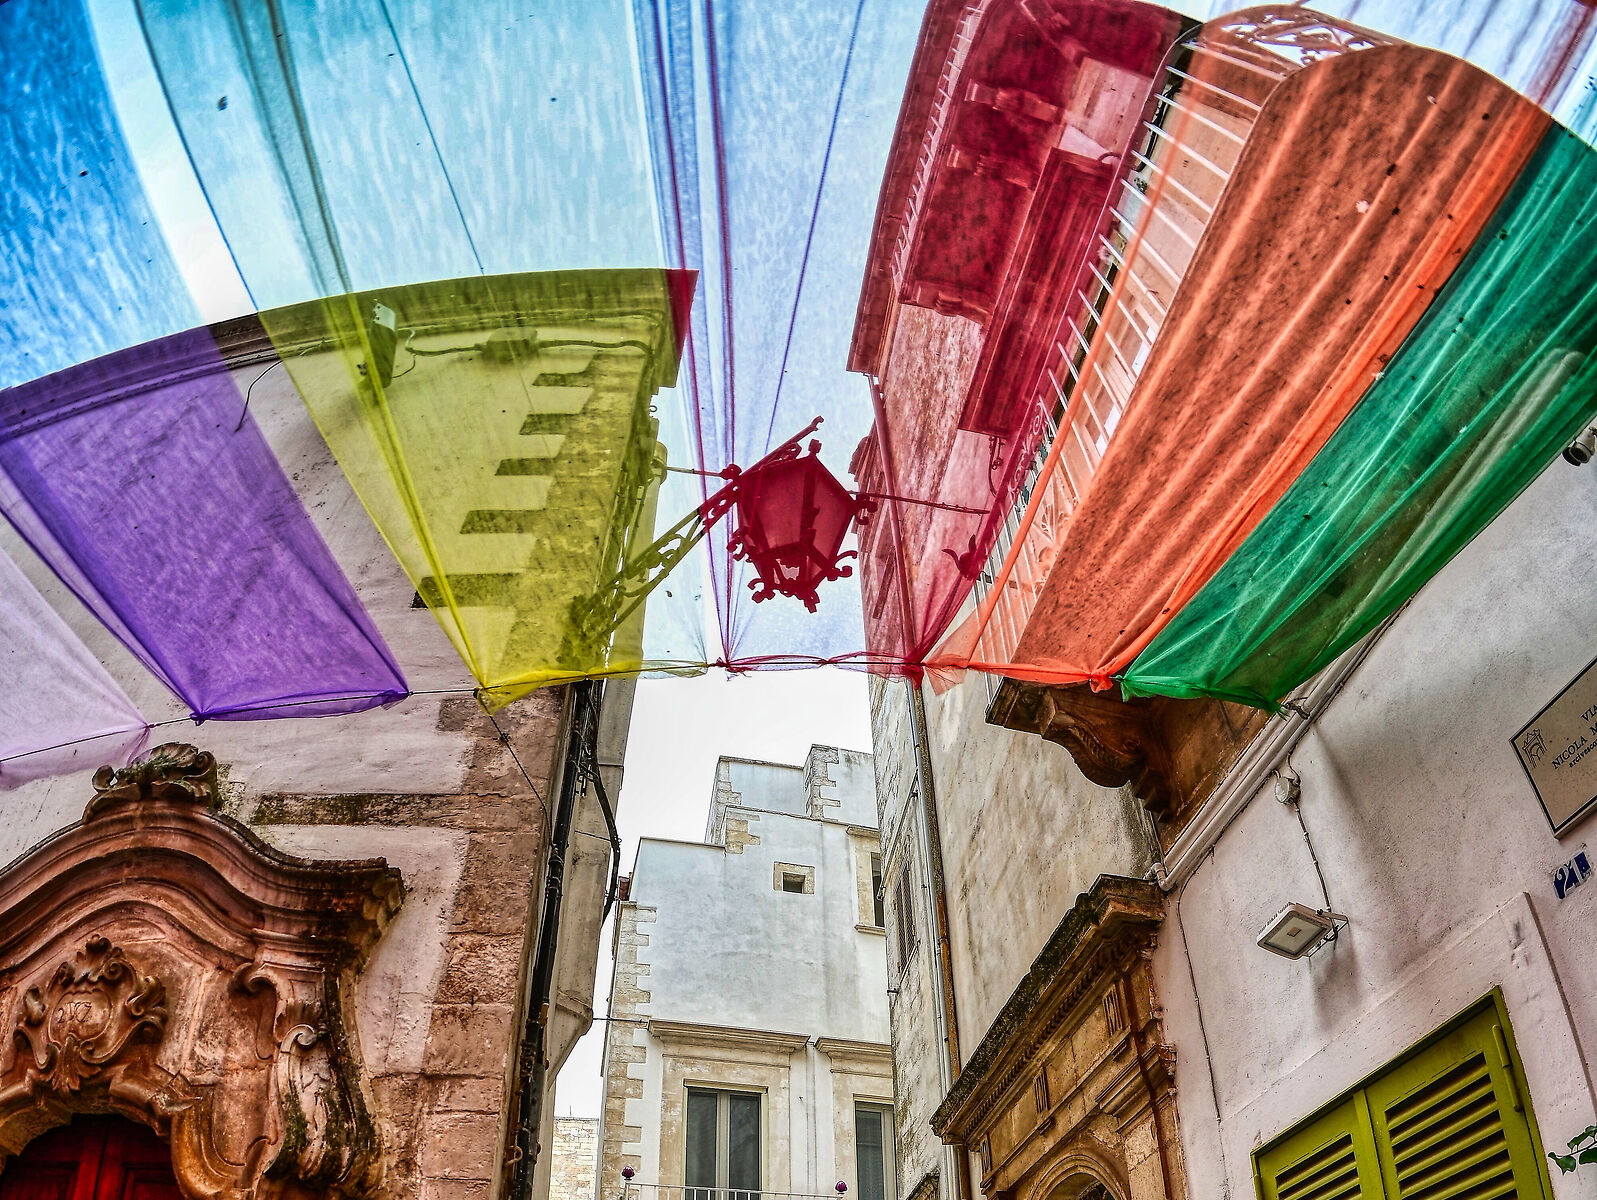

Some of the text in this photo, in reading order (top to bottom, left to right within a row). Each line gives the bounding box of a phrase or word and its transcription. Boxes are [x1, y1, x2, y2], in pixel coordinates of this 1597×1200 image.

[1580, 703, 1597, 721] VIA
[1551, 735, 1588, 770] NICOLA
[1568, 739, 1597, 768] arcivesco
[1555, 857, 1584, 897] 21
